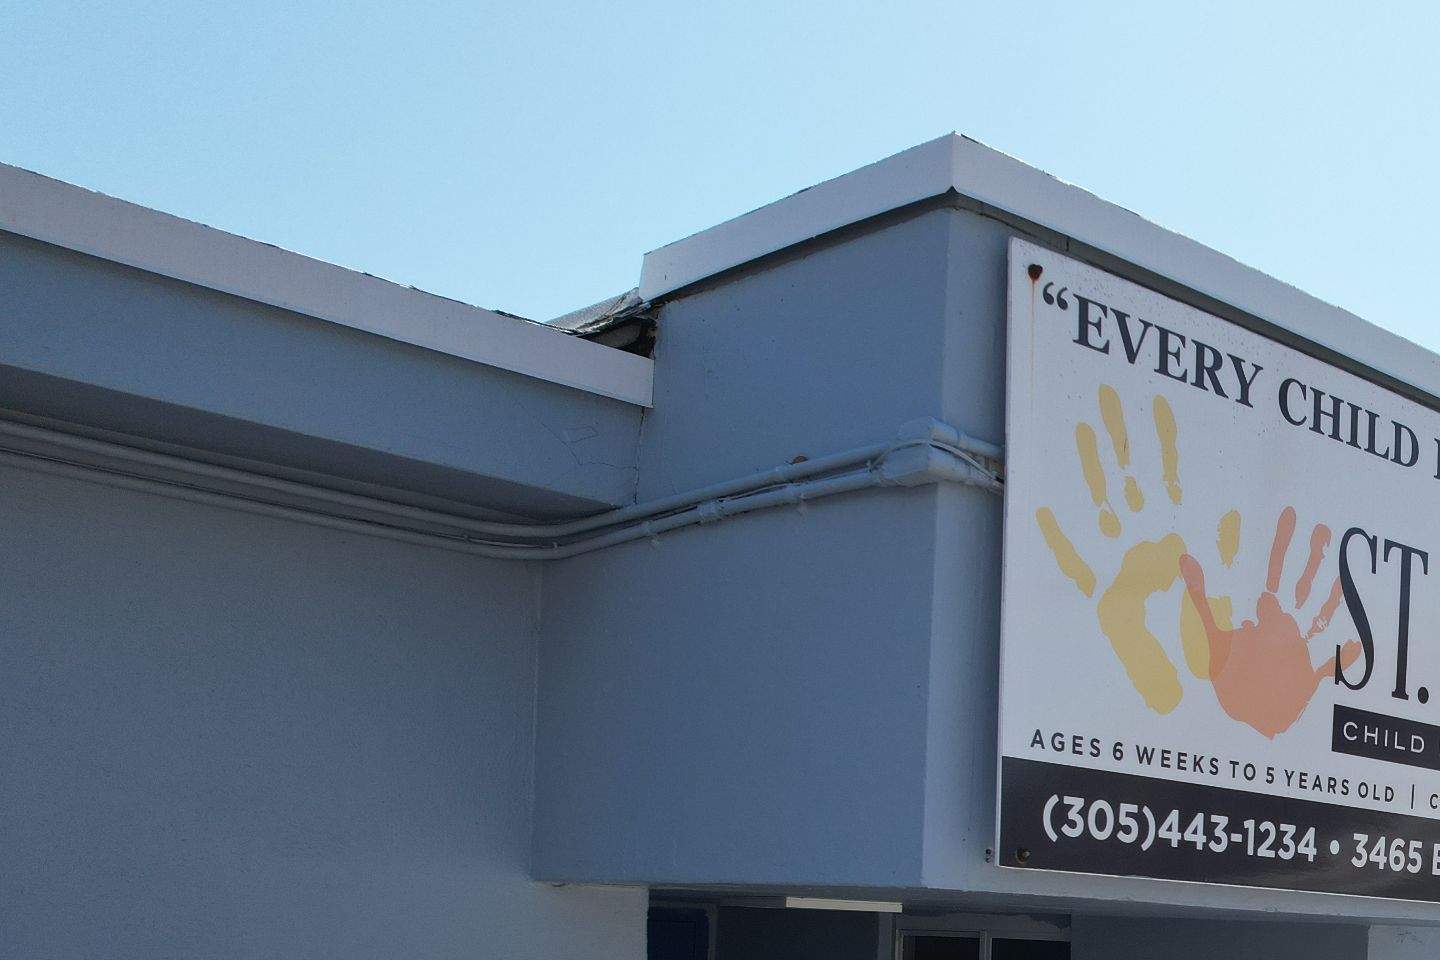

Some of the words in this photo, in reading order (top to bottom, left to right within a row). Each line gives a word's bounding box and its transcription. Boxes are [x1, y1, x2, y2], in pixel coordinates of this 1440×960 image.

[1278, 377, 1420, 468] CHILD
[1335, 527, 1429, 705] ST.
[1030, 729, 1101, 758] AGES
[1112, 741, 1124, 761] 6
[1136, 745, 1219, 776] WEEKS
[1229, 761, 1257, 782] TO
[1266, 767, 1275, 785] 5
[1284, 769, 1350, 796] YEARS
[1358, 781, 1395, 803] OLD
[1343, 721, 1425, 753] CHILD
[1042, 793, 1317, 862] (305)443-1234
[1351, 832, 1423, 875] 3465
